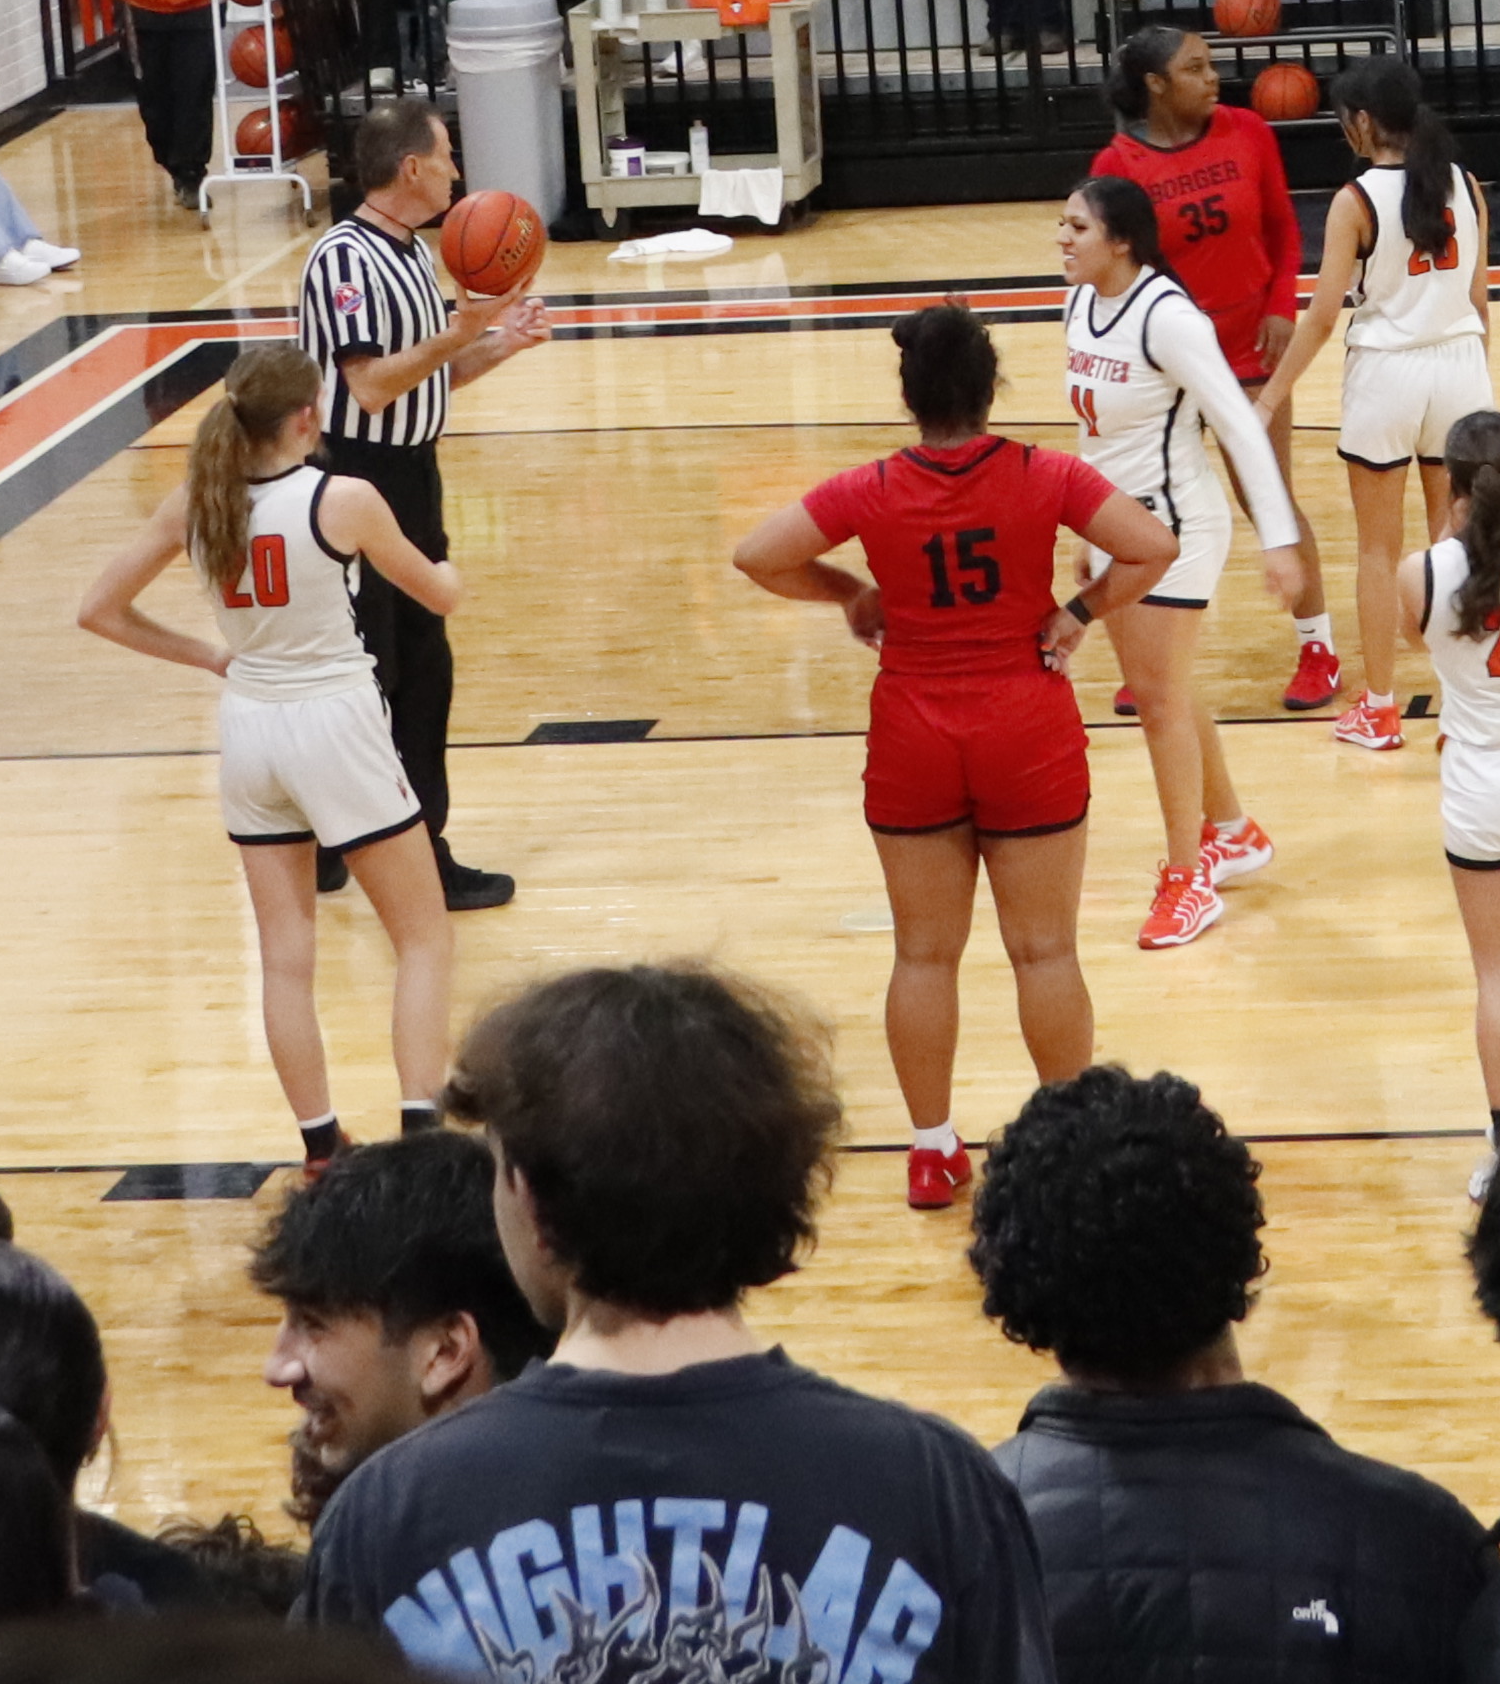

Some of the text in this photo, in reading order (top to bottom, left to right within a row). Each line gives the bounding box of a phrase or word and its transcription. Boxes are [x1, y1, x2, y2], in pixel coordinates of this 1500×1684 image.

[1151, 157, 1243, 205] BORGER
[1178, 195, 1229, 244] 35
[1066, 357, 1130, 385] EMONETTES
[222, 534, 290, 608] 20
[922, 526, 1002, 609] 15
